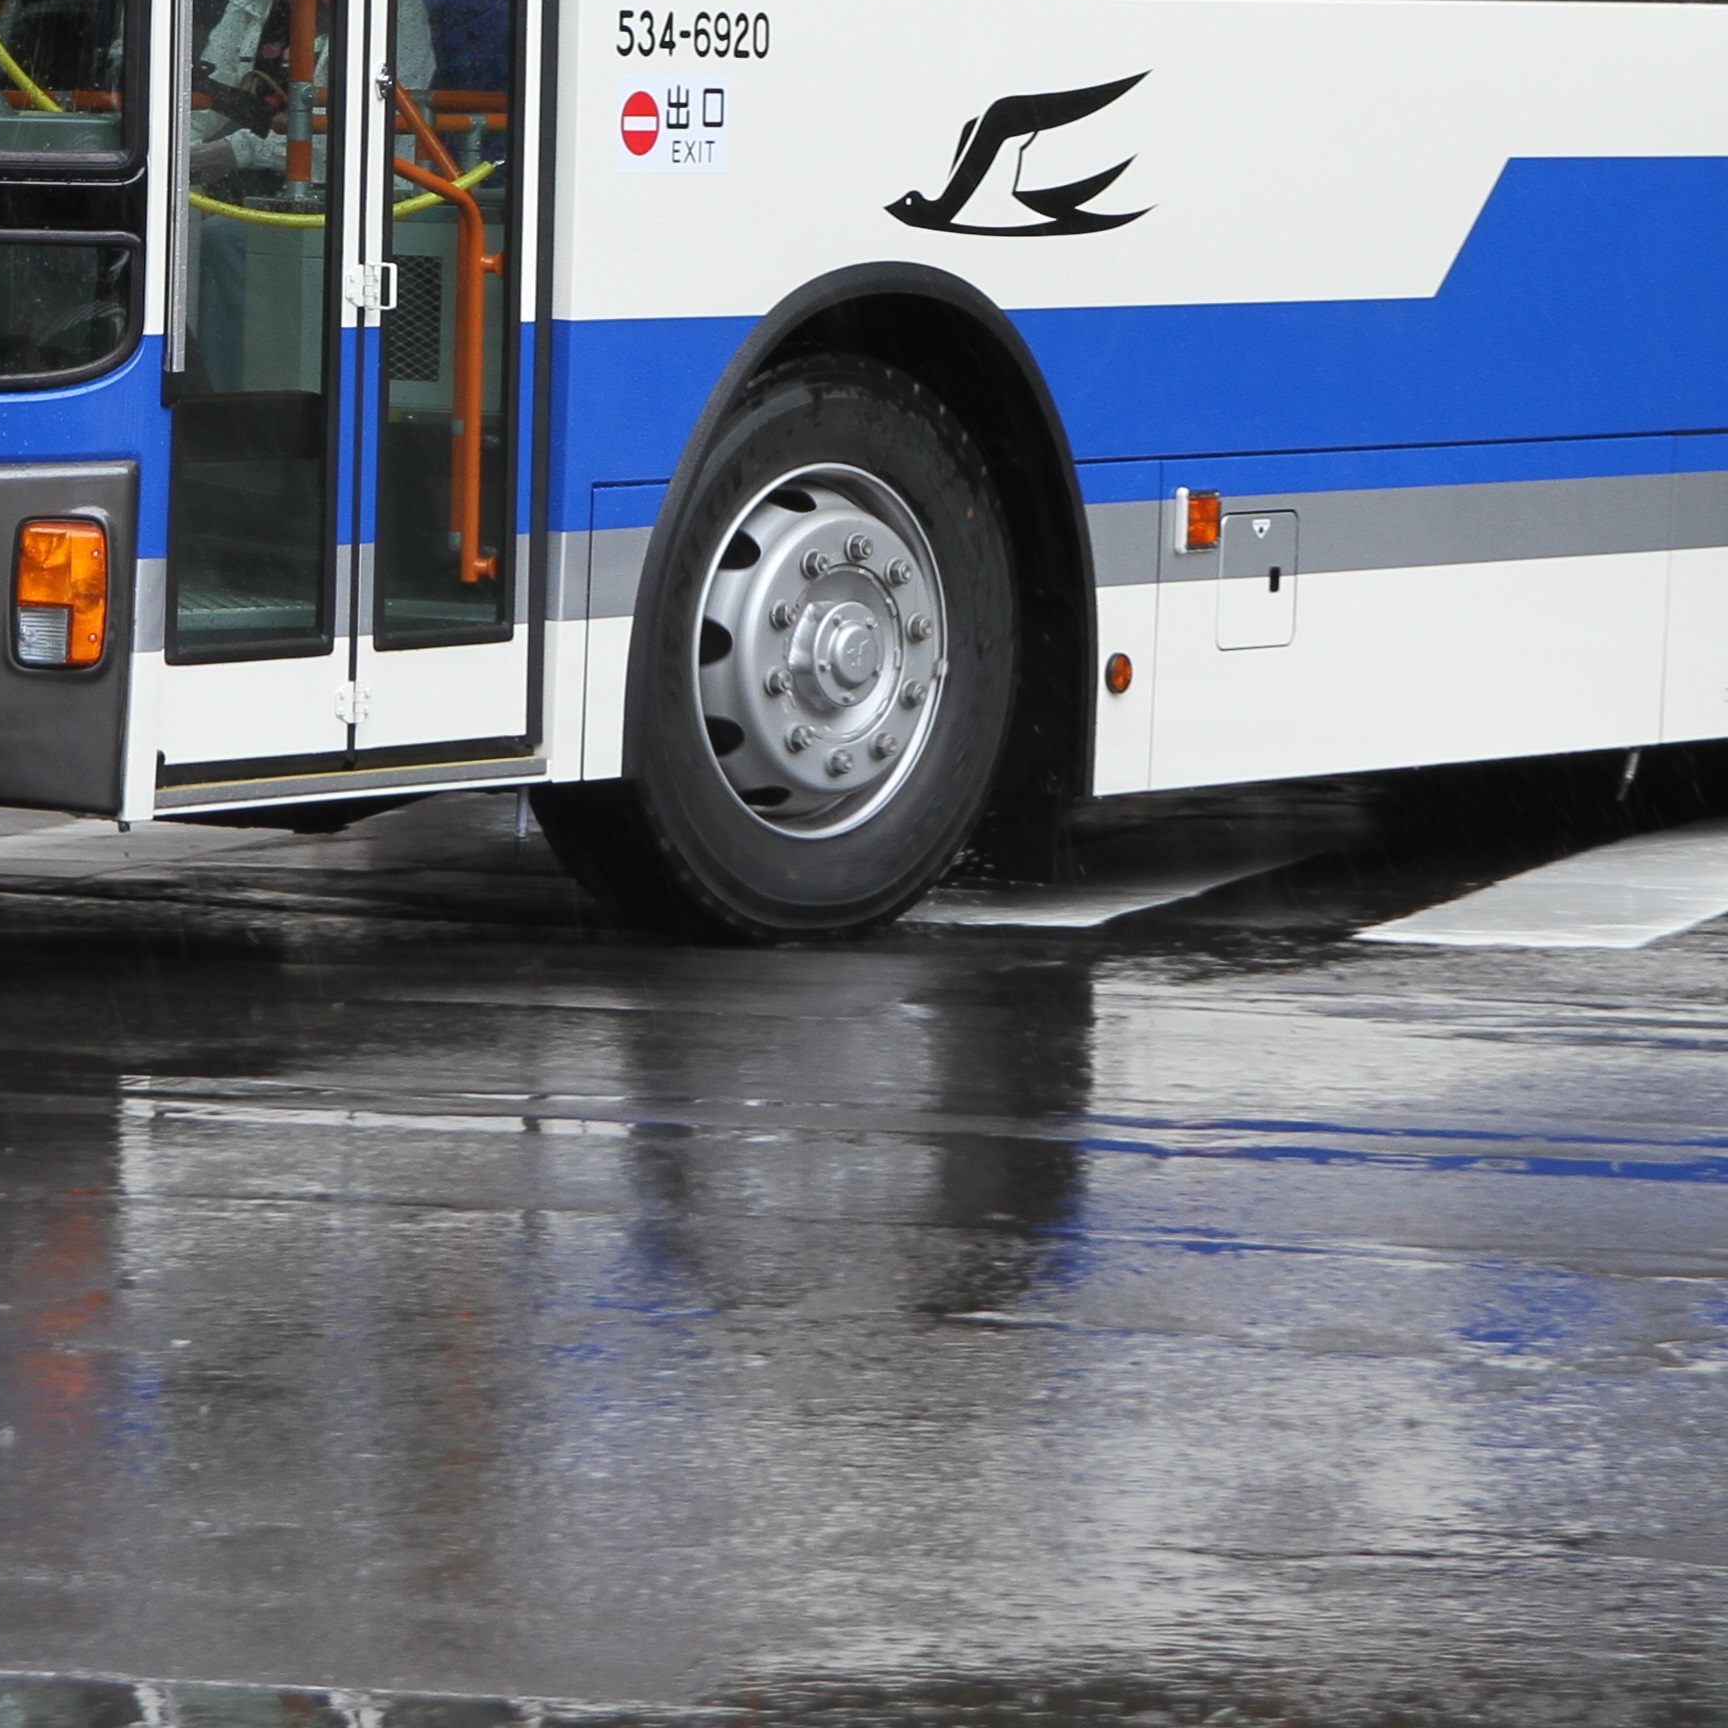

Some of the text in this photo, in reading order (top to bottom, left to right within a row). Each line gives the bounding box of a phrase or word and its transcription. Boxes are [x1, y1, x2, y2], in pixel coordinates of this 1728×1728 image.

[616, 9, 770, 59] 534-6920
[666, 84, 725, 130] 出口
[671, 140, 716, 163] EXIT
